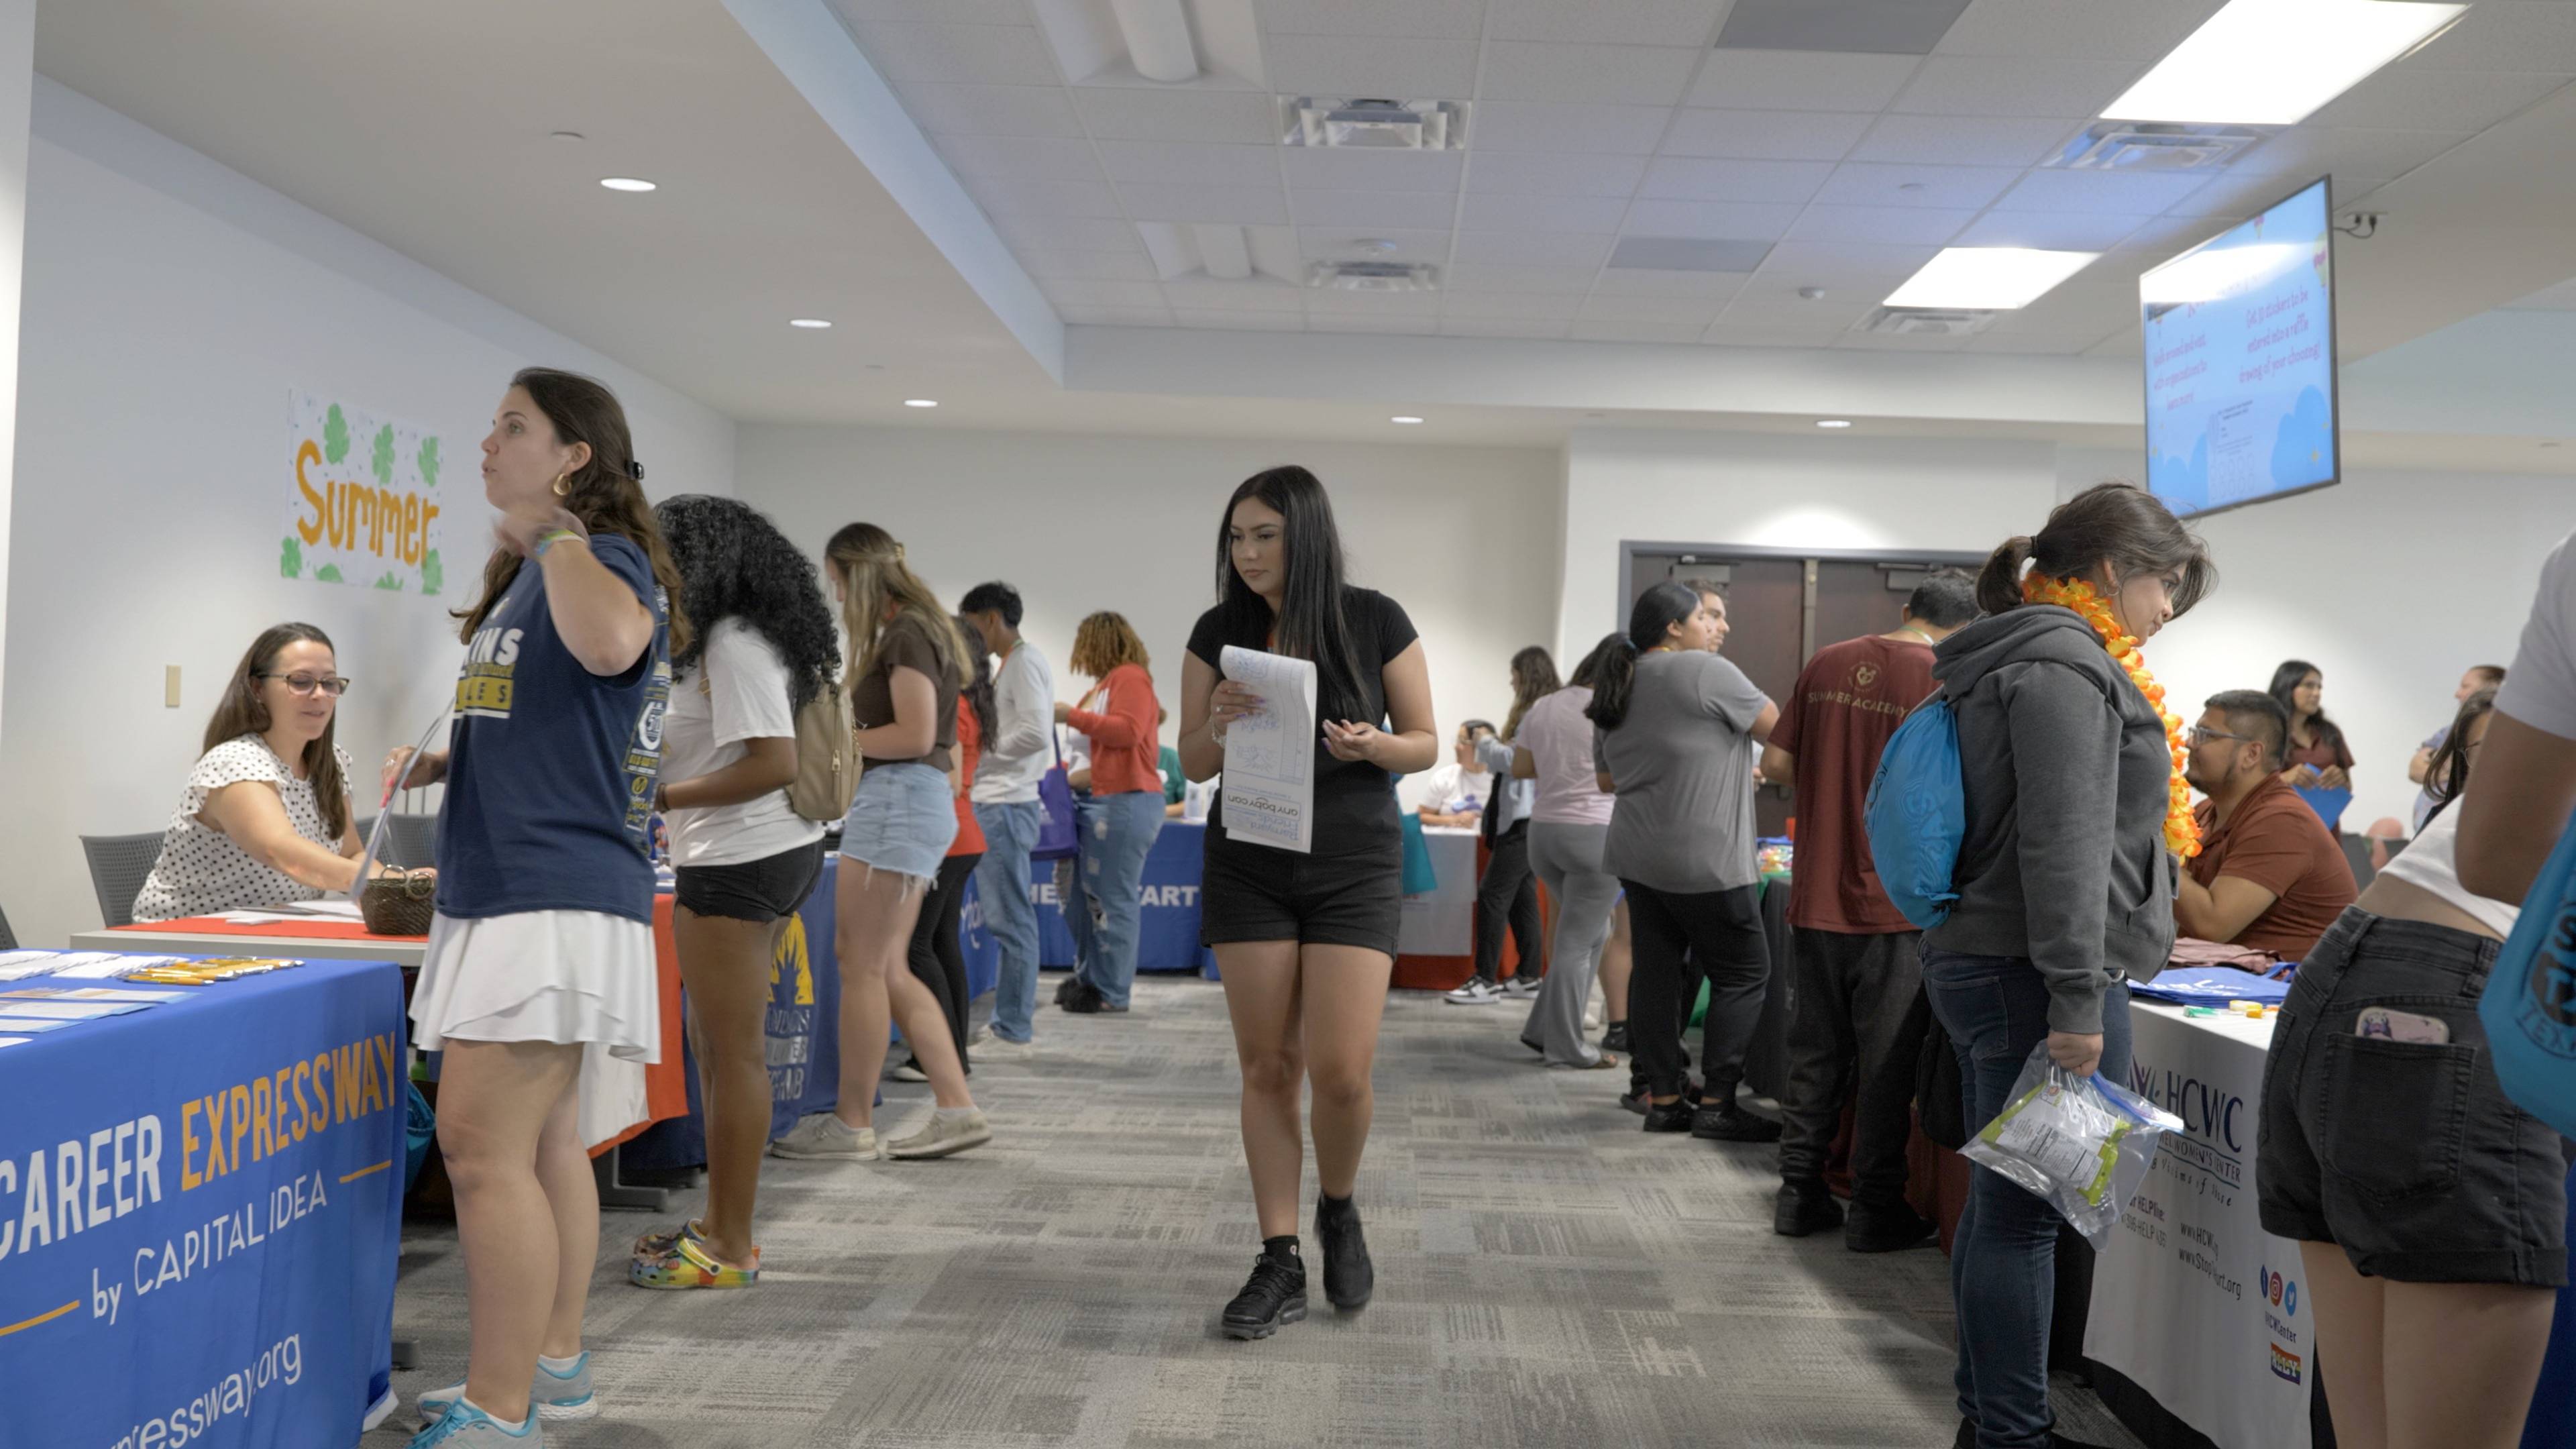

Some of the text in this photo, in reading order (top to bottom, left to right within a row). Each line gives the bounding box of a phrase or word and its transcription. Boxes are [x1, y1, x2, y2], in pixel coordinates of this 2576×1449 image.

[296, 438, 440, 570] Summer
[1807, 690, 1909, 718] SUMMER ACADEMY
[1227, 794, 1299, 816] any baby can
[1137, 885, 1200, 907] ART
[2166, 1070, 2244, 1152] HCWC
[0, 1031, 396, 1260] CAREER EXPRESSWAY
[2215, 1156, 2241, 1183] ENTER
[92, 1169, 327, 1326] by CAPITAL IDEA
[109, 1333, 302, 1449] ressway.org
[2271, 1350, 2299, 1378] ALLY
